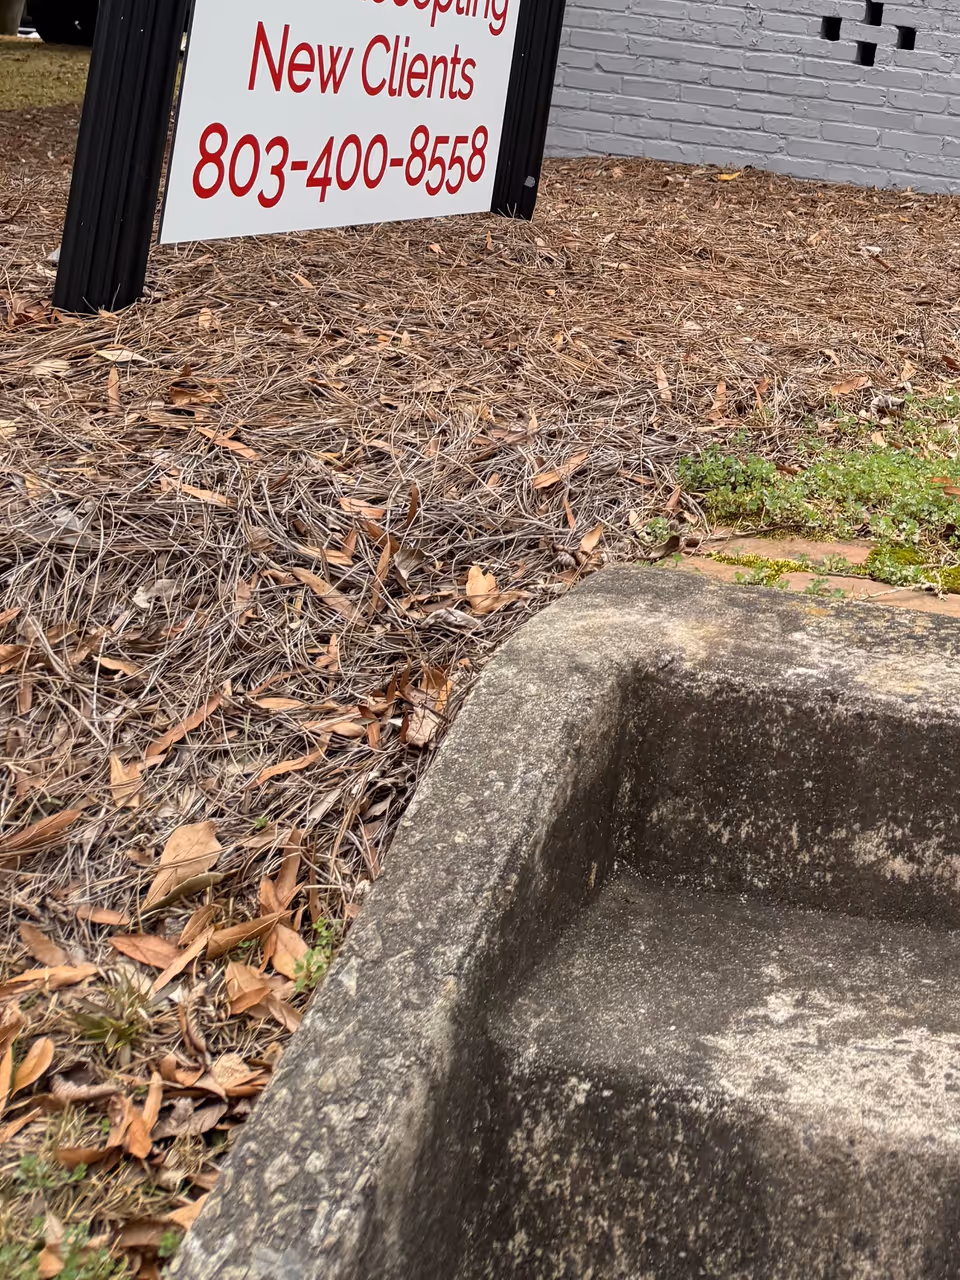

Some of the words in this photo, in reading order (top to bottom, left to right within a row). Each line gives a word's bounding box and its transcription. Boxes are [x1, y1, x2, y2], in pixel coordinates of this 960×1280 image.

[248, 21, 354, 94] New
[361, 34, 477, 100] Clients
[192, 122, 489, 209] 803-400-8558
